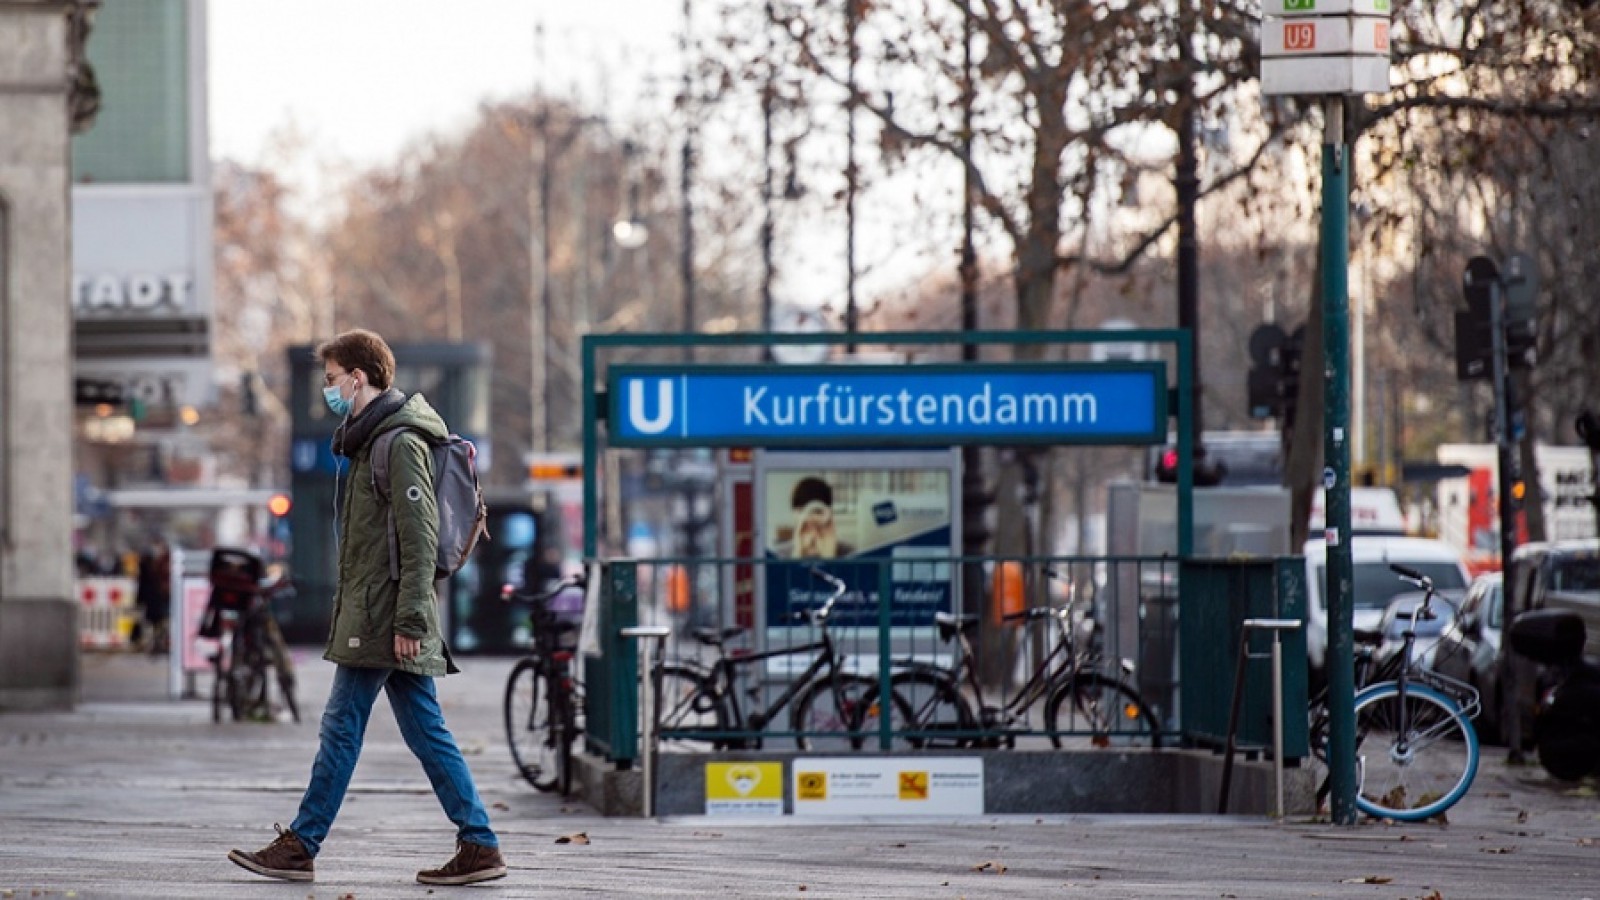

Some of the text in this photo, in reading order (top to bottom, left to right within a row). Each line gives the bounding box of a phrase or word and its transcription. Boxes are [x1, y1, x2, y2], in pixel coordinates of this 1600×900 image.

[1287, 25, 1312, 47] U9
[629, 378, 1097, 435] U Kurfürstendamm
